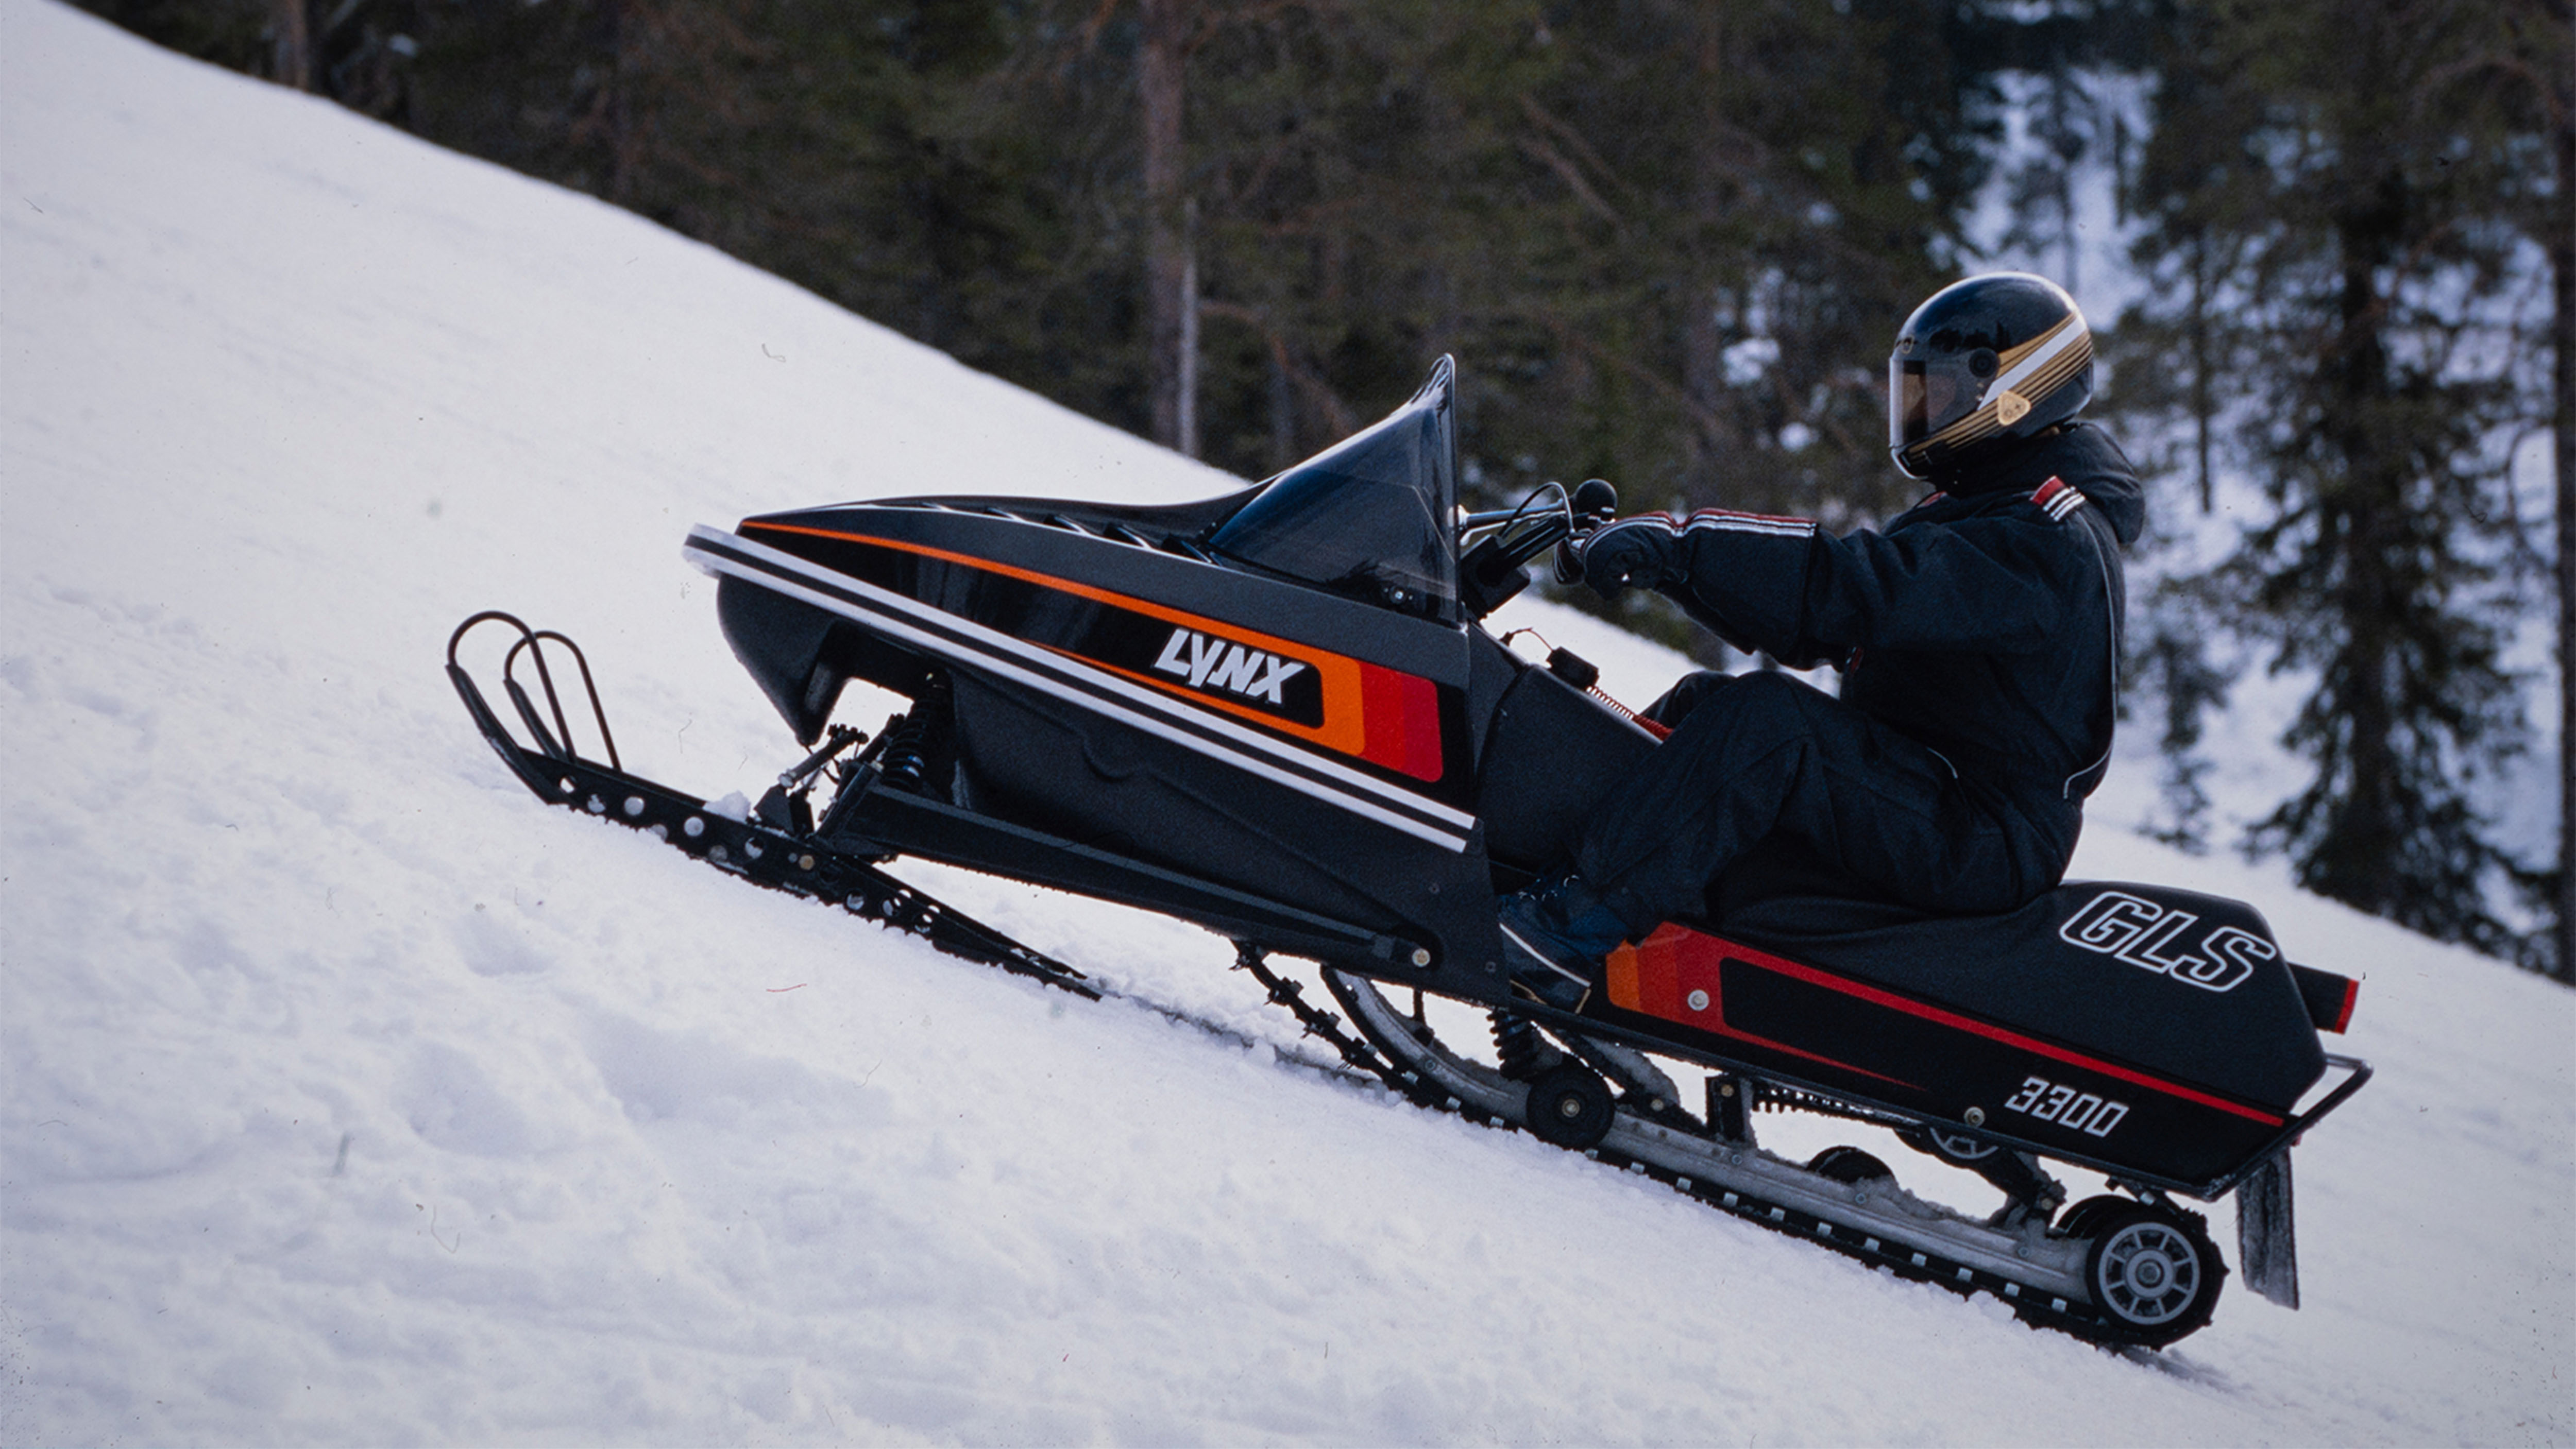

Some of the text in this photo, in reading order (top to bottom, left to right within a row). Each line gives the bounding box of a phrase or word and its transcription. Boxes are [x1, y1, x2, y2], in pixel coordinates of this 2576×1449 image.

[1154, 628, 1306, 704] LYNX
[2059, 891, 2277, 992] GLS
[2005, 1077, 2129, 1137] 3300
